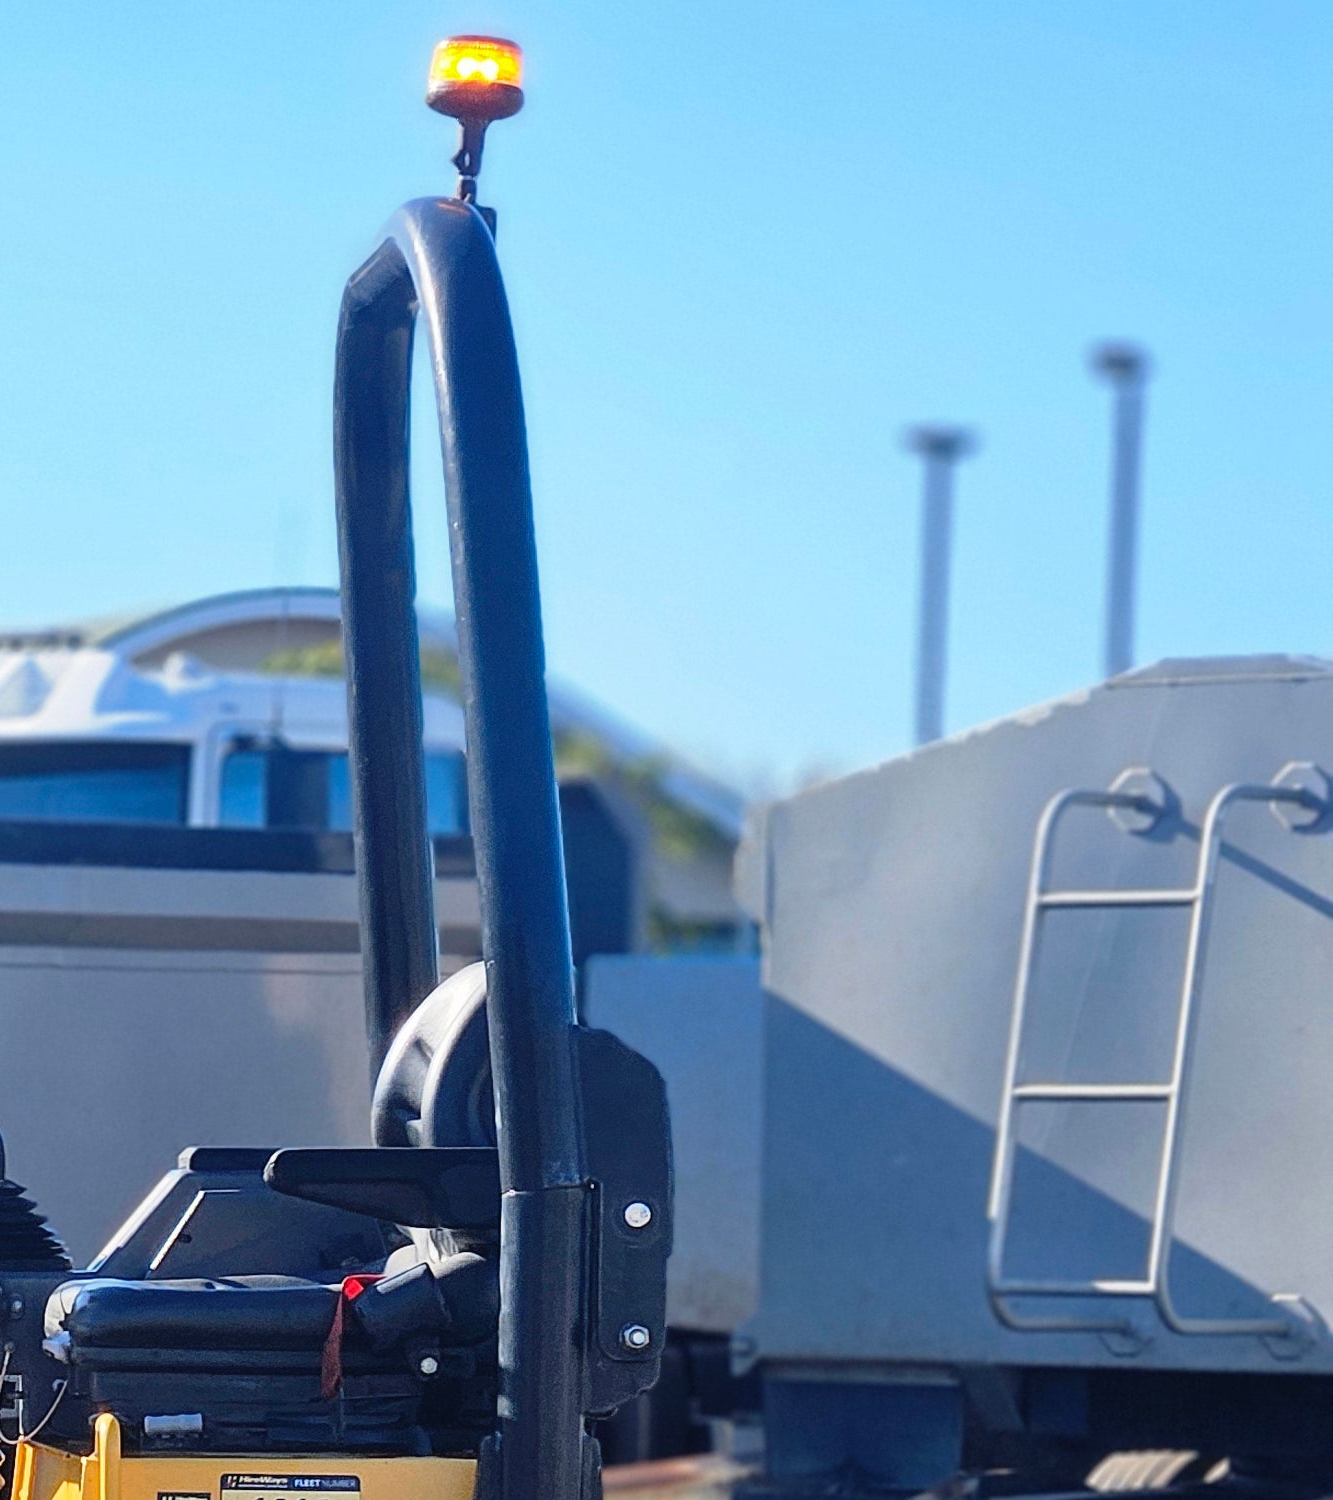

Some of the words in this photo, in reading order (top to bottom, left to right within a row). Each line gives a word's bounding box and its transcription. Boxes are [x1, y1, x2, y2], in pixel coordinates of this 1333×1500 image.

[238, 1476, 288, 1485] HireWays
[294, 1479, 320, 1487] FLEET
[322, 1479, 356, 1488] NUMBER
